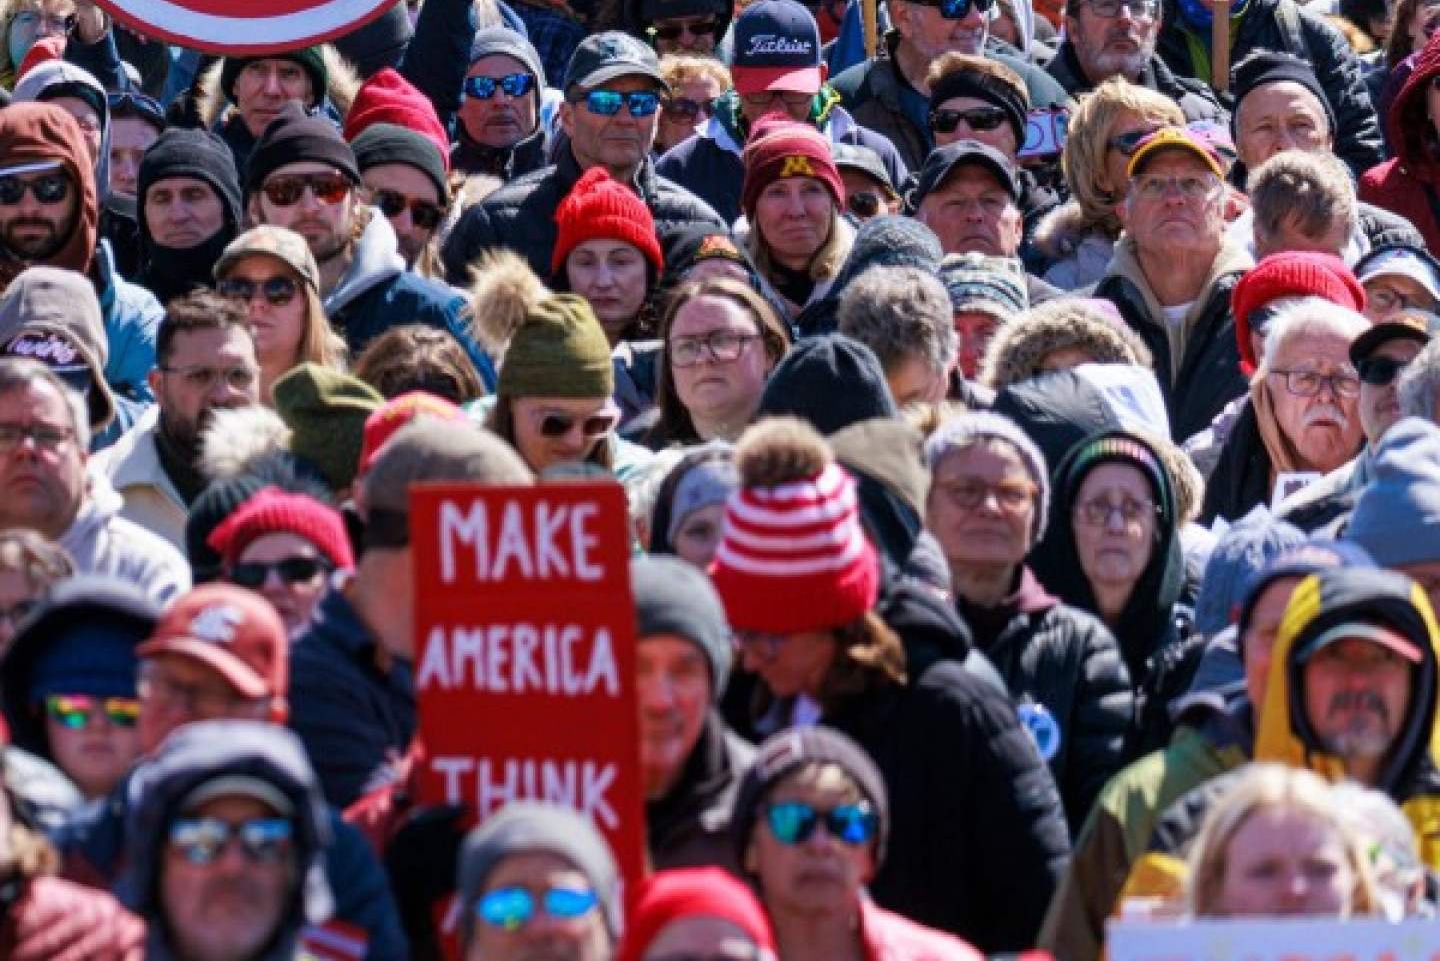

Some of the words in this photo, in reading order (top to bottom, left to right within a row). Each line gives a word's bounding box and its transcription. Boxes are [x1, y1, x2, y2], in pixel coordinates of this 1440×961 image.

[780, 154, 814, 176] M
[438, 497, 604, 582] MAKE
[417, 622, 620, 695] AMERICA
[430, 756, 620, 829] THINK
